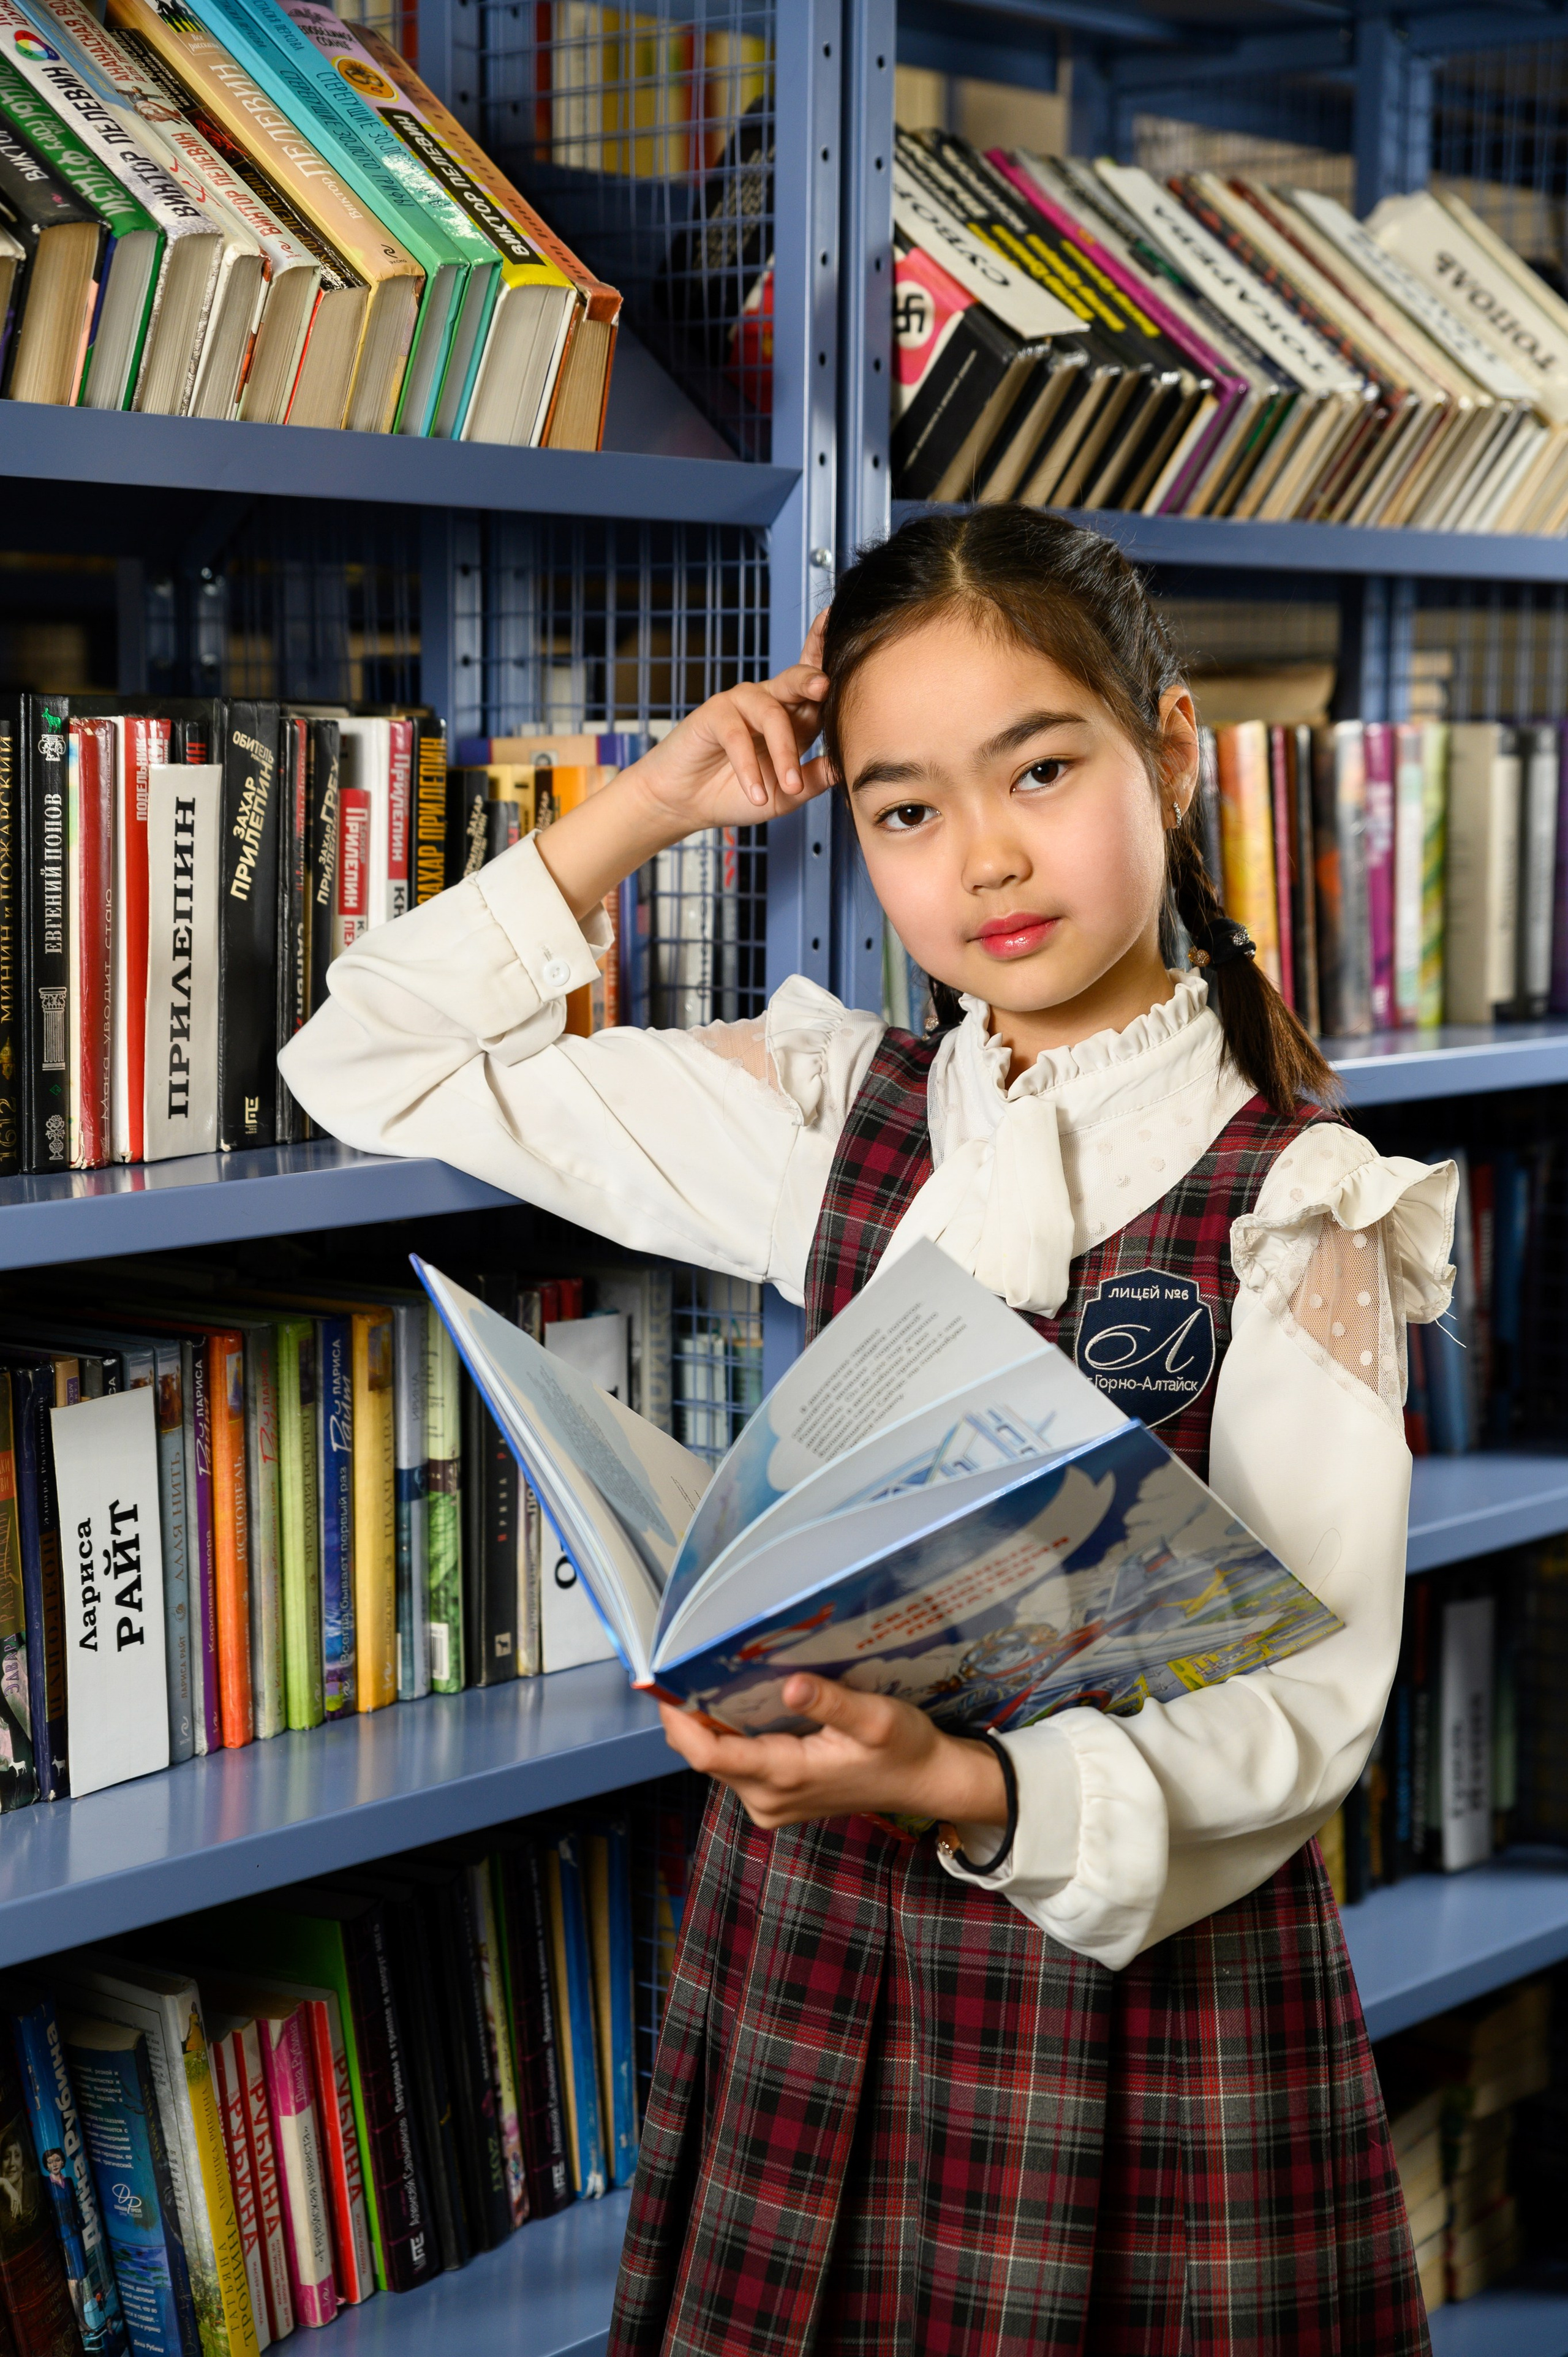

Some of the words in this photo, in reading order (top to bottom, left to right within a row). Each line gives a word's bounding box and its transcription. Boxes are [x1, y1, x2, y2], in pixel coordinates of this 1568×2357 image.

[44, 0, 75, 17] ВО
[274, 23, 305, 51] ПЕРКОВА
[64, 20, 134, 81] АНАНАСНАЯ
[126, 66, 148, 83] ДЛЯ
[41, 66, 135, 146] ПЕЛЕВИН
[44, 119, 66, 135] НА
[208, 64, 332, 179] ПЕЛЕВИН
[316, 71, 381, 129] СТЕРЕГУЩИЕ
[24, 119, 66, 151] ГОРУ
[170, 132, 238, 186] ПЕЛЕВИН
[280, 69, 341, 128] СТЕРЕГУЩИЕ
[333, 128, 382, 170] ЗОЛОТО
[372, 173, 416, 208] ГРИФЫ
[392, 114, 466, 189] ПЕЛЕВИН
[56, 149, 137, 217] ФУДЗИ
[119, 151, 202, 218] ВИКТОР
[225, 189, 284, 237] ВИКТОР
[241, 172, 303, 232] ПЕЛЕВИН
[322, 176, 364, 220] Виктор
[463, 190, 530, 257] ВИКТОР
[1153, 204, 1325, 375] ТОКАРЕВА
[1434, 248, 1559, 370] ТОПОЛЬ
[136, 737, 148, 821] ПОДЕЛЬНИК
[232, 730, 275, 764] ОБИТЕЛЬ
[0, 735, 13, 902] ПОЖАРСКИЙ
[233, 776, 257, 840] ЗАХАР
[320, 754, 339, 825] ГРЕХ
[390, 753, 410, 862] ПРИЛЕПИН
[418, 737, 448, 842] ПРИЛЕПИН
[467, 794, 483, 837] ЗАХАР
[44, 793, 62, 859] ПОПОВ
[230, 759, 274, 902] ПРИЛЕПИН
[318, 824, 333, 865] ЗАХАР
[344, 806, 368, 908] ПРИЛЕПИН
[40, 867, 62, 954] ЕВГЕНИЙ
[0, 930, 13, 1024] МИНИН
[168, 796, 196, 1120] ПРИЛЕПИН
[103, 963, 112, 1046] уводит
[100, 1056, 110, 1119] Мага
[0, 1096, 17, 1161] 1612
[1108, 1285, 1160, 1301] ЛИЦЕЙ
[1164, 1288, 1189, 1300] №6
[194, 1359, 205, 1417] ЛАРИСА
[262, 1349, 271, 1406] ЛАРИСА
[331, 1339, 342, 1395] ЛАРИСА
[1095, 1374, 1199, 1393] Горно-Алтайск
[196, 1397, 213, 1477] Райт
[302, 1416, 312, 1478] ВСТРЕЧ
[330, 1375, 352, 1453] Райт
[170, 1450, 183, 1517] НИТЬ
[233, 1455, 246, 1561] ИСПОВЕДЬ
[339, 1466, 349, 1492] раз
[303, 1483, 314, 1563] МЕЛОДИЯ
[339, 1496, 350, 1552] первый
[0, 1510, 15, 1623] РАДЗИНСКИЙ
[78, 1517, 101, 1653] Лариса
[102, 1499, 145, 1653] РАЙТ
[339, 1556, 352, 1609] бывает
[3, 1632, 21, 1699] ЭДВАРД
[178, 1635, 187, 1659] РАЙТ
[340, 1614, 351, 1664] Всегда
[179, 1660, 188, 1699] ЛАРИСА
[46, 2019, 82, 2158] Рубина
[391, 2059, 405, 2114] Петровы
[249, 2080, 280, 2239] РУБИНА
[334, 2054, 364, 2206] РУБИНА
[399, 2116, 414, 2179] Сальников
[66, 2152, 102, 2251] Дина
[228, 2096, 258, 2257] РУБИНА
[407, 2181, 422, 2228] Алексей
[217, 2241, 239, 2335] ТАТЬЯНА
[225, 2210, 253, 2347] ТРОНИНА
